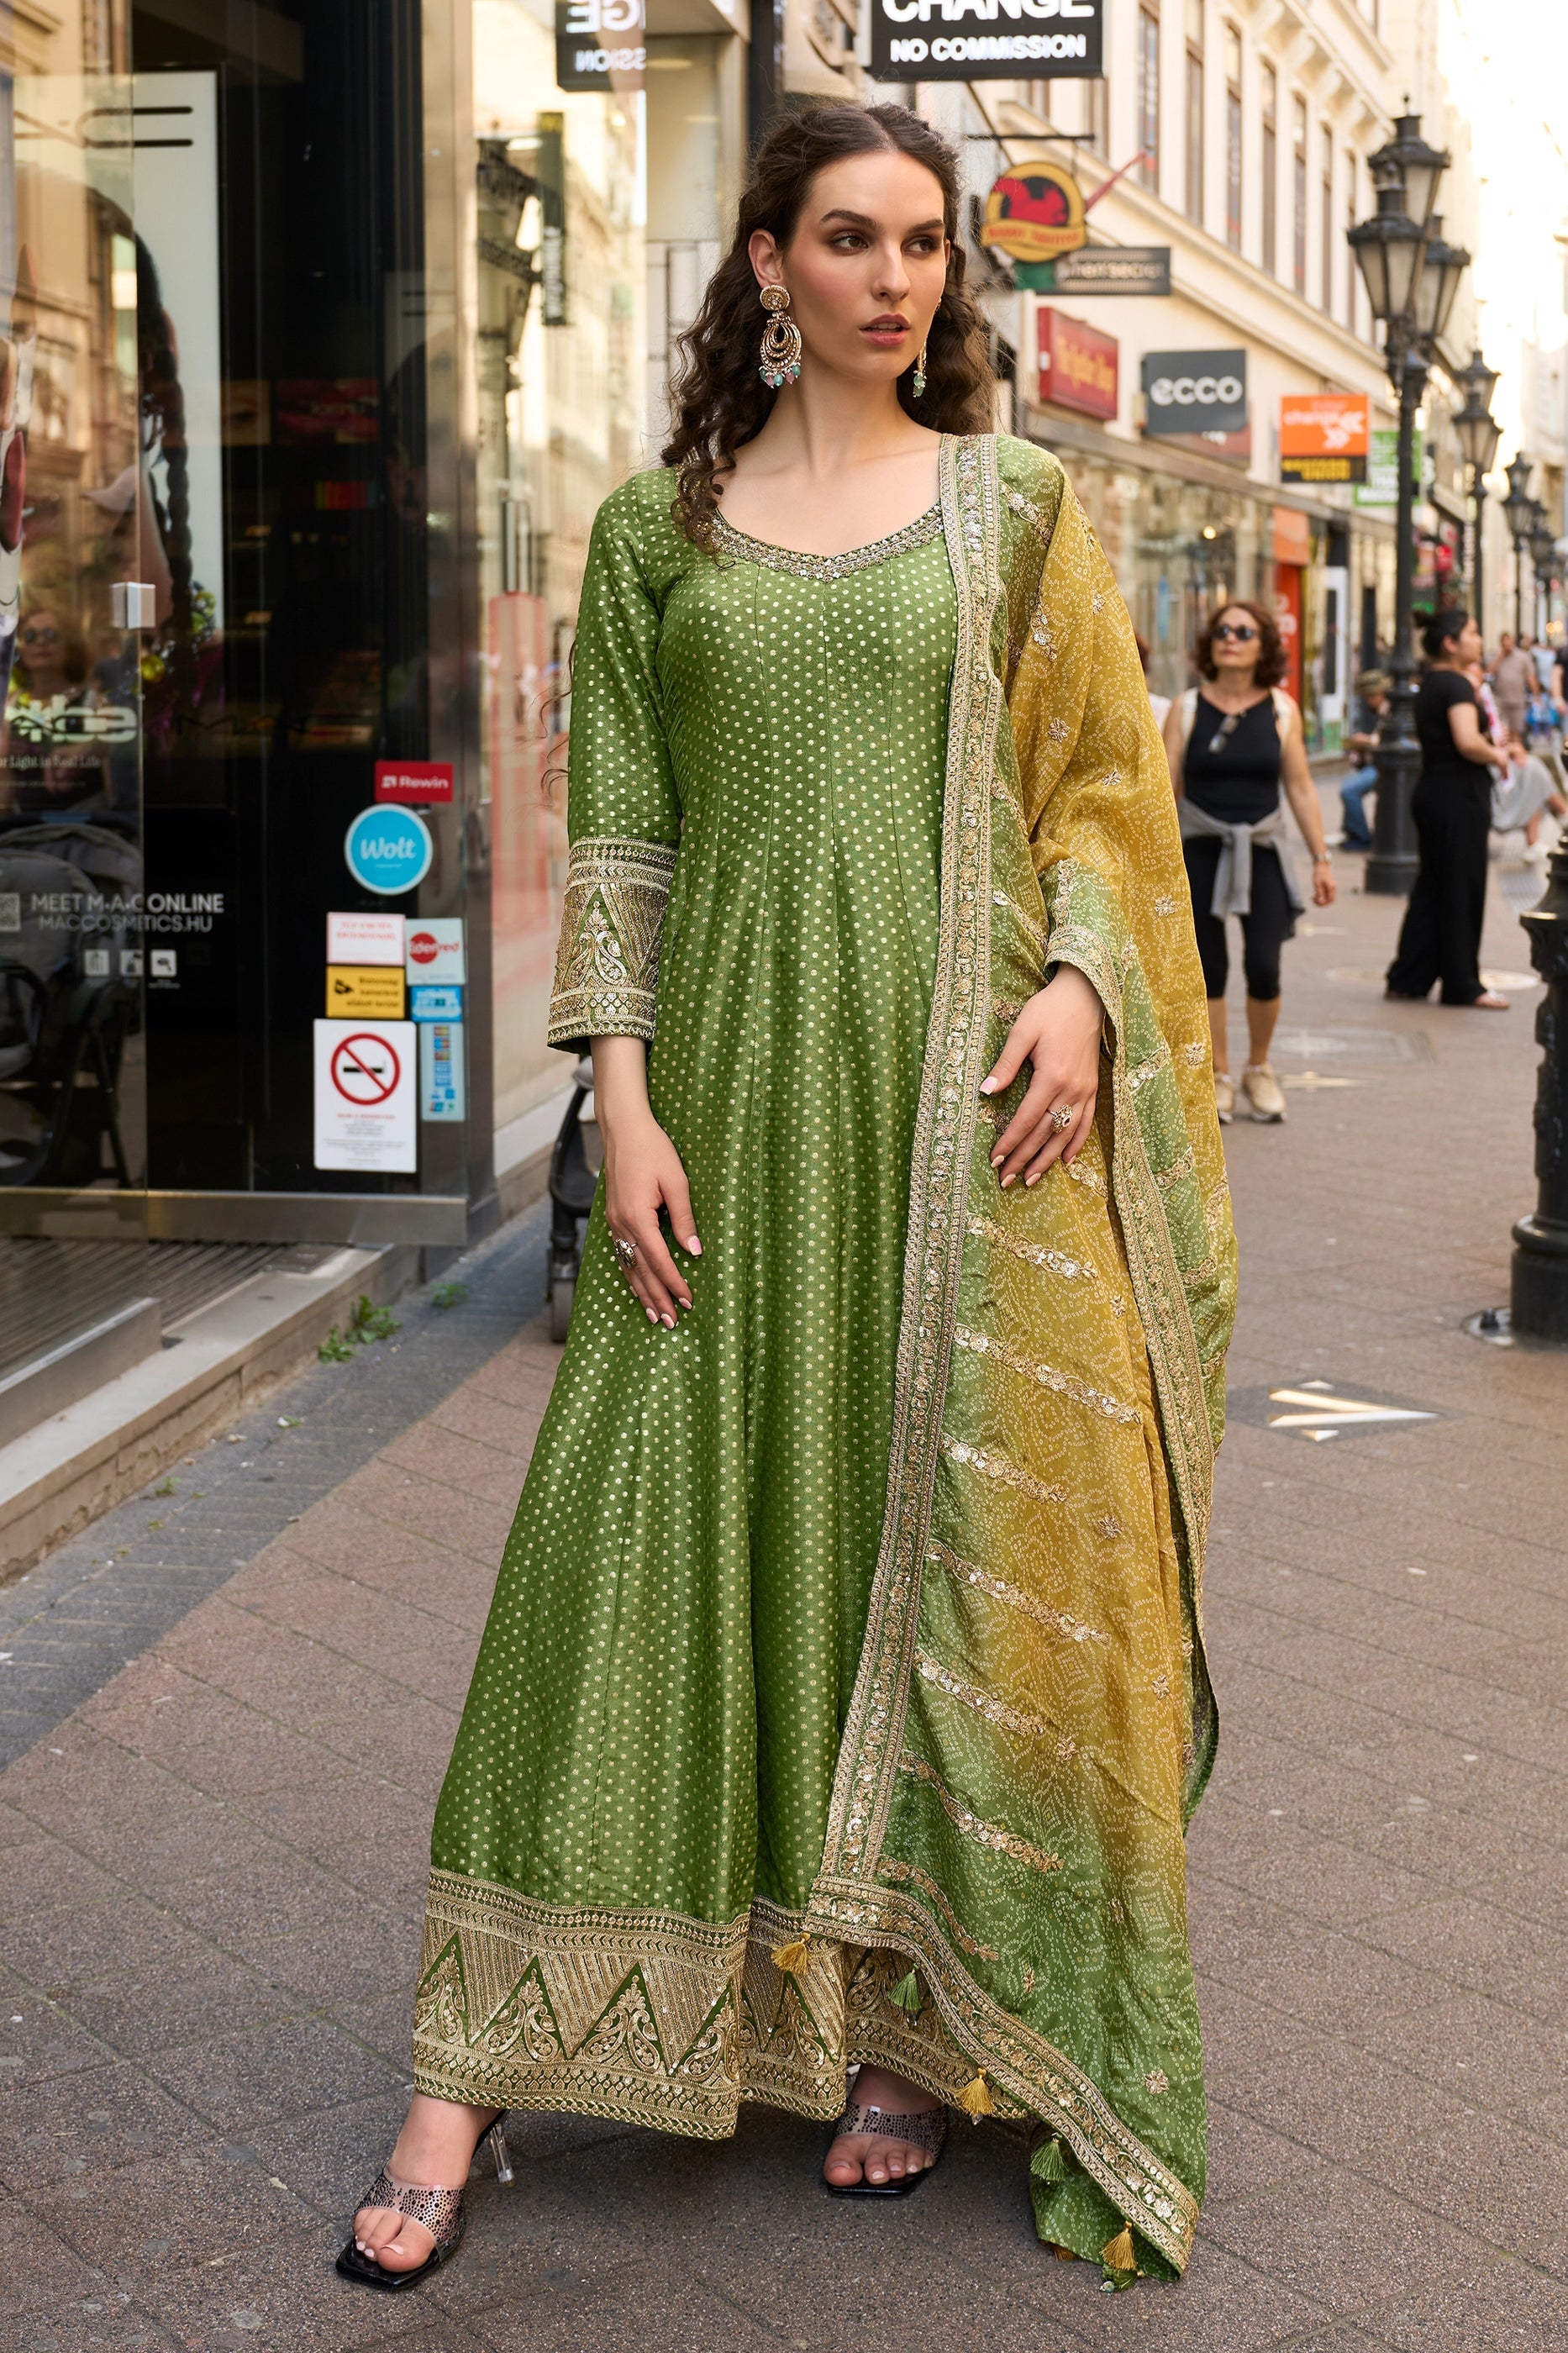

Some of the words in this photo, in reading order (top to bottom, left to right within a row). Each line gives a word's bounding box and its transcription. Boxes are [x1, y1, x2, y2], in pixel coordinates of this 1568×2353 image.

[891, 39, 928, 61] NO
[931, 34, 1086, 61] COMMISSION
[1150, 376, 1242, 406] ecco
[399, 776, 449, 788] Rewin
[360, 837, 416, 860] Wolt
[31, 893, 82, 913] MEET
[148, 893, 224, 913] ONLINE
[39, 914, 213, 933] MACCOSMETICS.HU
